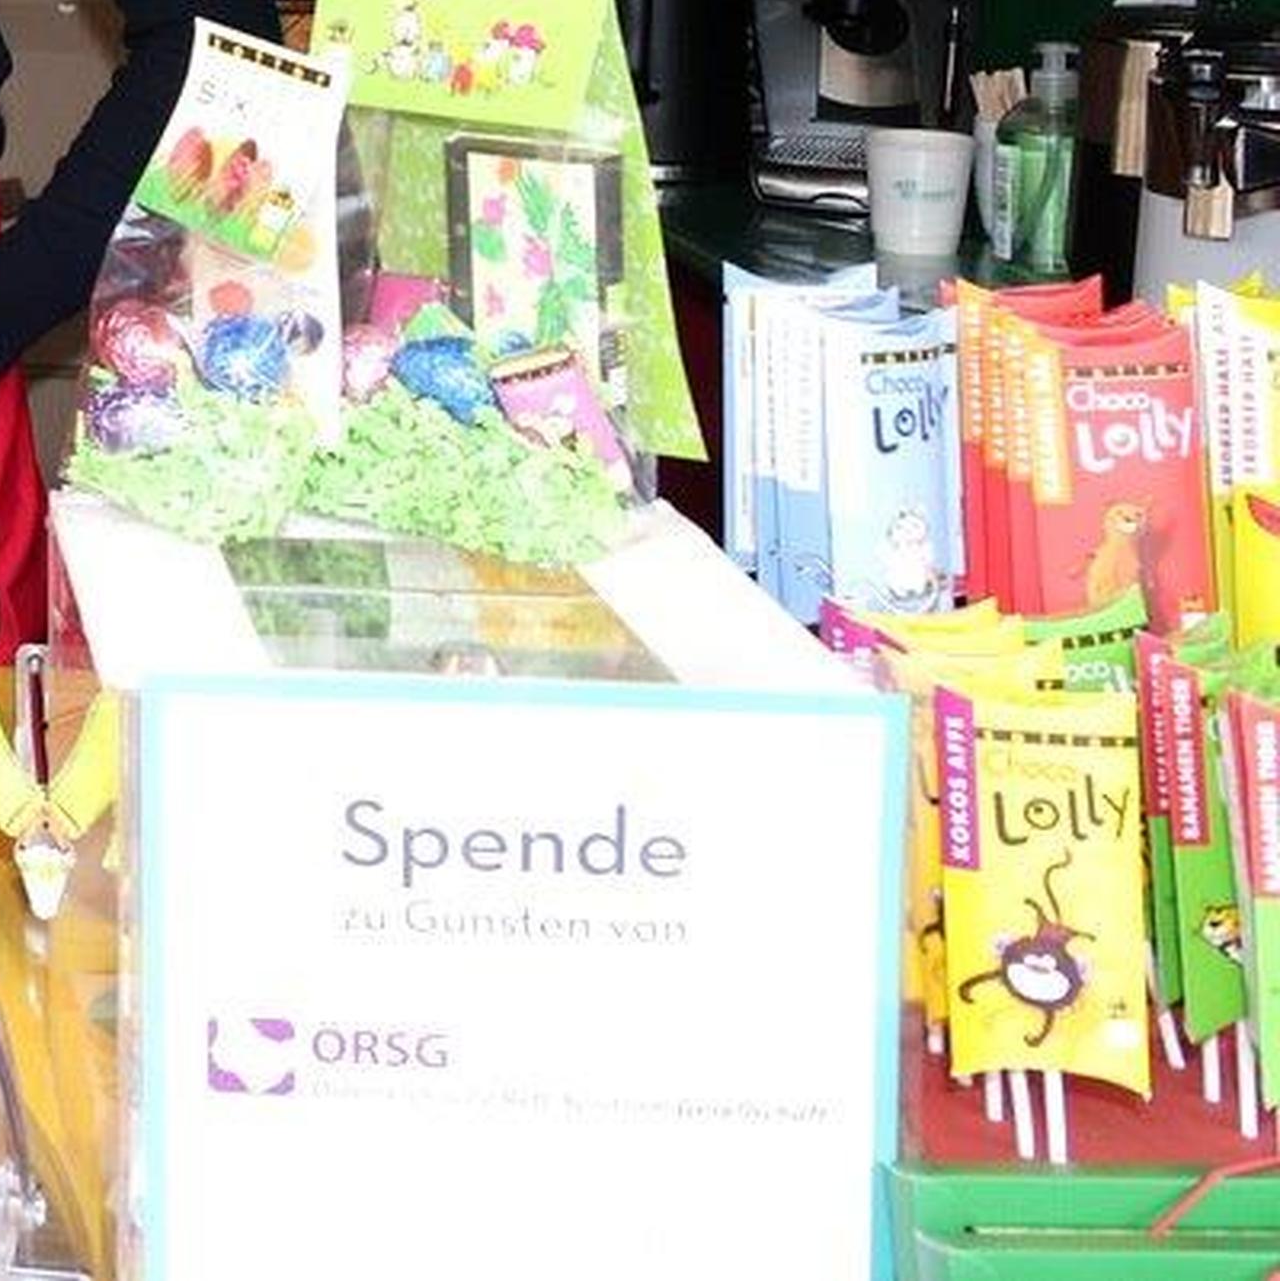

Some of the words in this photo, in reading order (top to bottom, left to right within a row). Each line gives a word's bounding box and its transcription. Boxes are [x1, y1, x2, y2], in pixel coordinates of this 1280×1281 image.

[1075, 396, 1195, 474] Lolly
[944, 716, 968, 772] AFFE
[342, 799, 686, 888] Spende
[948, 774, 972, 862] KOKOS
[993, 773, 1131, 846] Lolly
[405, 899, 591, 939] Gunsten
[609, 919, 687, 942] von
[312, 1021, 449, 1069] ÖRSG
